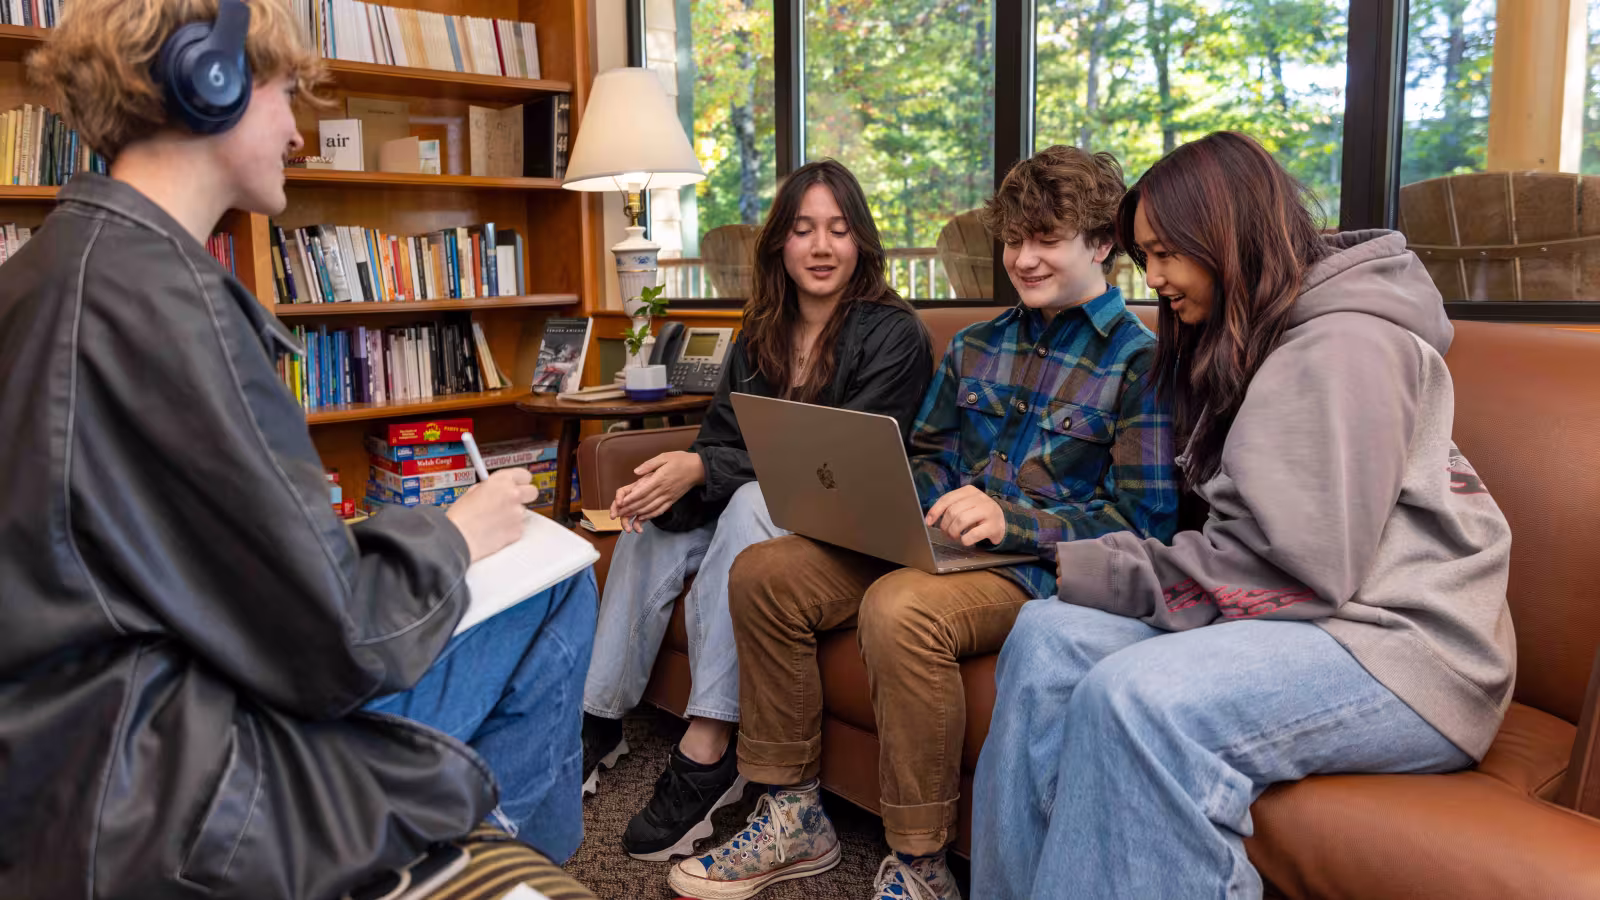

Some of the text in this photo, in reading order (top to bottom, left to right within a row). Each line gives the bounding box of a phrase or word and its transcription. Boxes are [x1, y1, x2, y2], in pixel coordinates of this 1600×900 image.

[326, 134, 350, 148] air
[435, 457, 453, 465] Corgi
[484, 453, 533, 467] CANDY LAND
